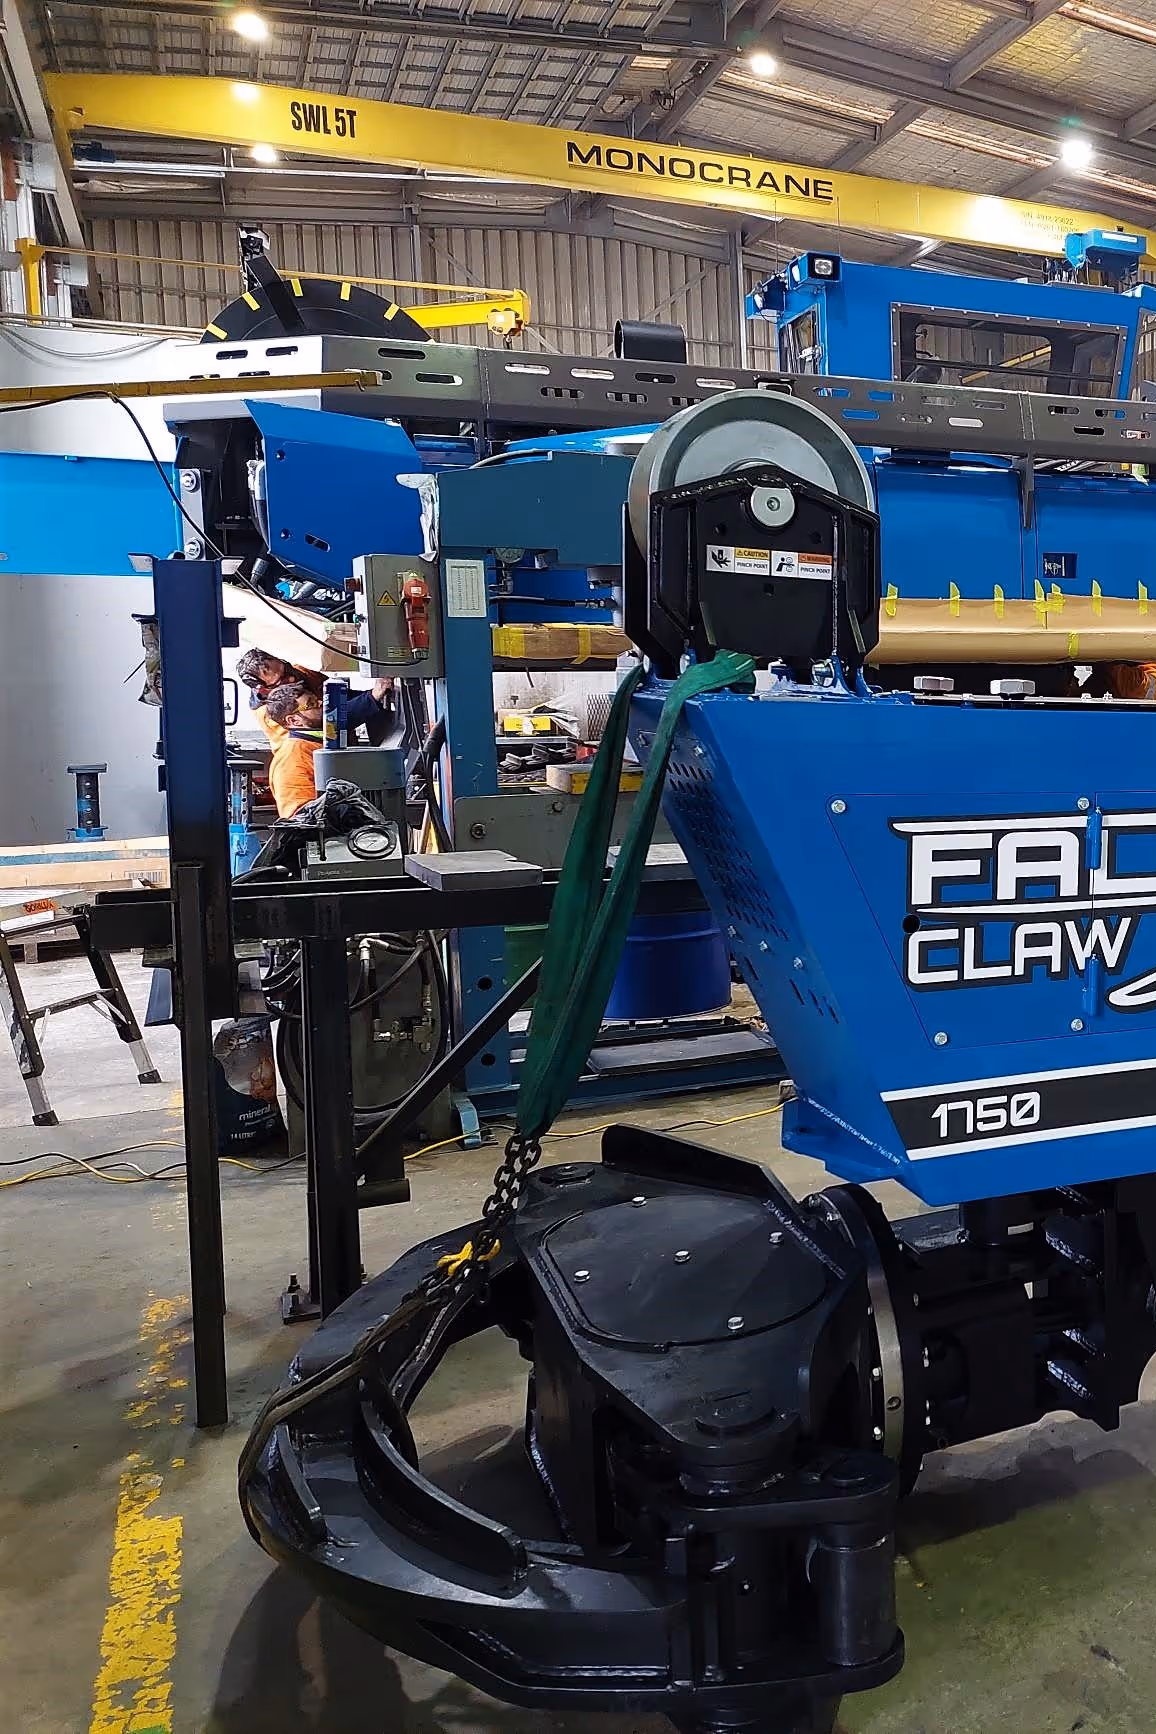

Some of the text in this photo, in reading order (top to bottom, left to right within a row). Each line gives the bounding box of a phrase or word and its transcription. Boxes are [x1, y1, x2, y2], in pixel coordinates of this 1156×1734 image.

[290, 101, 357, 138] SWL 5T
[567, 141, 833, 200] MONOCRANE
[743, 550, 769, 558] CAUTION
[908, 915, 1131, 985] CLAW
[931, 1092, 1041, 1138] 1750
